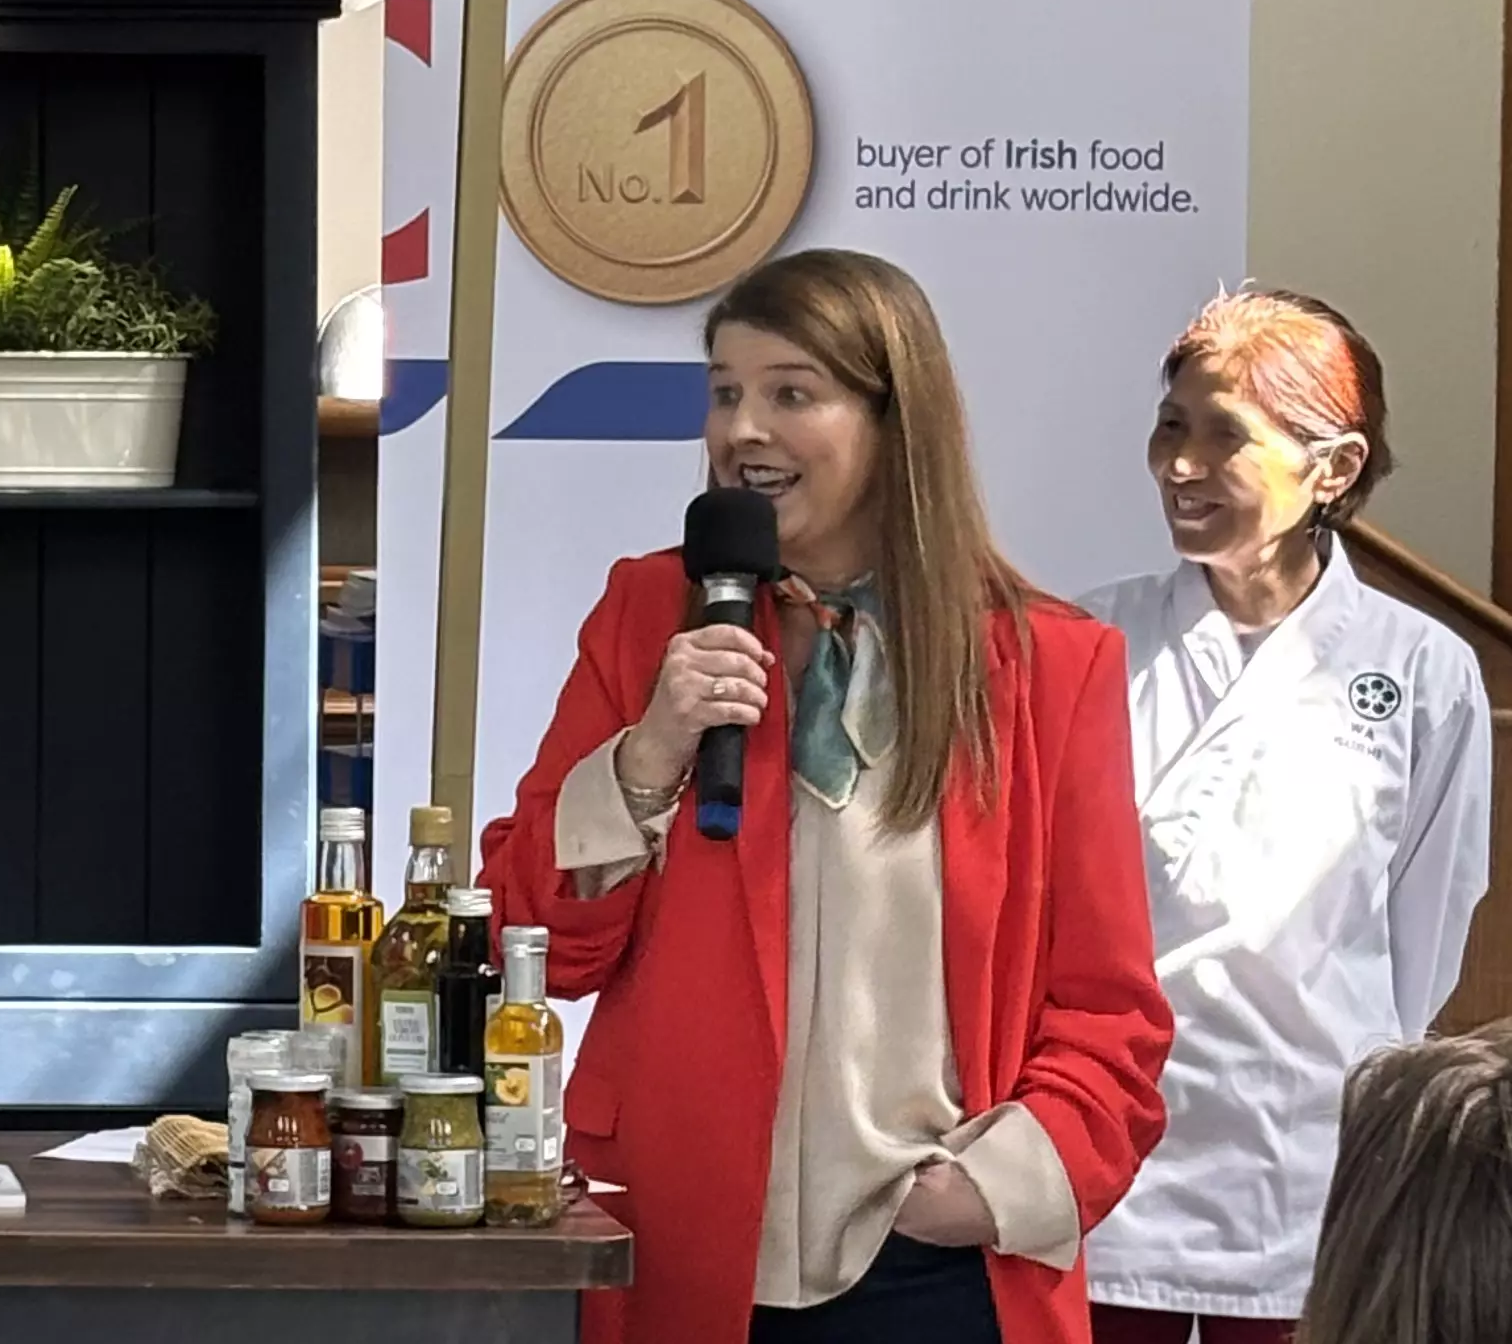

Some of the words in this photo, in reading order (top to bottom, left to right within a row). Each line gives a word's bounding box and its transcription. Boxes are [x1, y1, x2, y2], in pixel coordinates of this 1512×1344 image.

[857, 137, 951, 176] buyer
[960, 138, 995, 169] of
[1005, 139, 1077, 170] Irish
[1090, 140, 1164, 171] food
[855, 179, 916, 209] and
[927, 180, 1011, 211] drink
[1020, 182, 1199, 213] worldwide.
